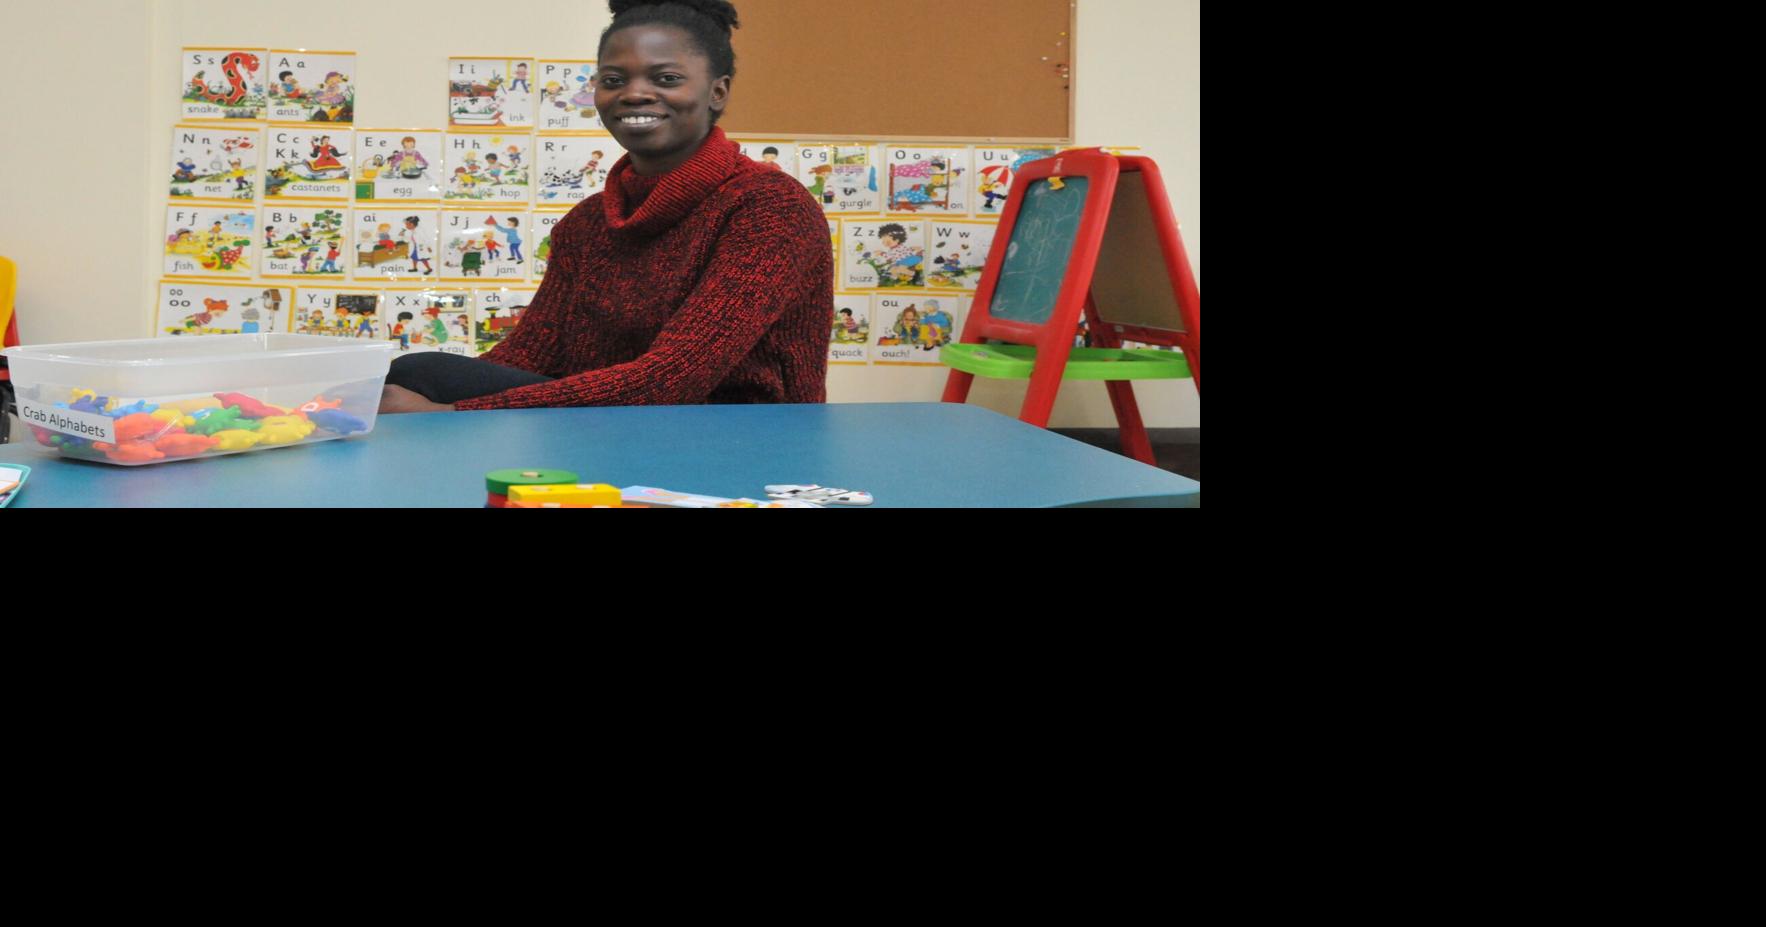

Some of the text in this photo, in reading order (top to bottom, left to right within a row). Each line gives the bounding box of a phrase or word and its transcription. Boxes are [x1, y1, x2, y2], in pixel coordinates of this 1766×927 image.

[193, 55, 215, 65] S s
[278, 57, 305, 69] A a
[458, 64, 465, 74] I
[546, 65, 571, 78] P p
[187, 105, 219, 114] snake
[276, 108, 300, 116] ants
[509, 112, 525, 122] ink
[547, 116, 569, 128] puff
[183, 133, 211, 145] N n
[276, 132, 300, 144] C c
[365, 136, 387, 148] E e
[454, 139, 480, 149] H h
[545, 141, 554, 151] R
[275, 148, 299, 160] K k
[801, 148, 827, 162] G g
[895, 149, 921, 160] O o
[983, 151, 1008, 161] U u
[204, 184, 222, 193] net
[291, 183, 341, 193] castanets
[393, 186, 412, 197] egg
[500, 188, 520, 198] hop
[839, 199, 872, 209] gurgle
[950, 202, 963, 210] on
[176, 212, 198, 225] F f
[272, 213, 298, 223] B b
[363, 213, 376, 223] ai
[450, 216, 469, 229] J j
[853, 227, 862, 237] Z
[936, 227, 952, 237] W
[173, 260, 194, 272] fish
[270, 261, 289, 270] bat
[380, 264, 405, 274] pain
[496, 265, 516, 276] jam
[850, 275, 873, 283] buzz
[307, 293, 331, 308] Y y
[396, 295, 405, 306] X
[485, 293, 500, 303] ch
[831, 349, 863, 358] quack
[882, 349, 910, 358] ouch!
[23, 406, 105, 438] Crab Alphabets
